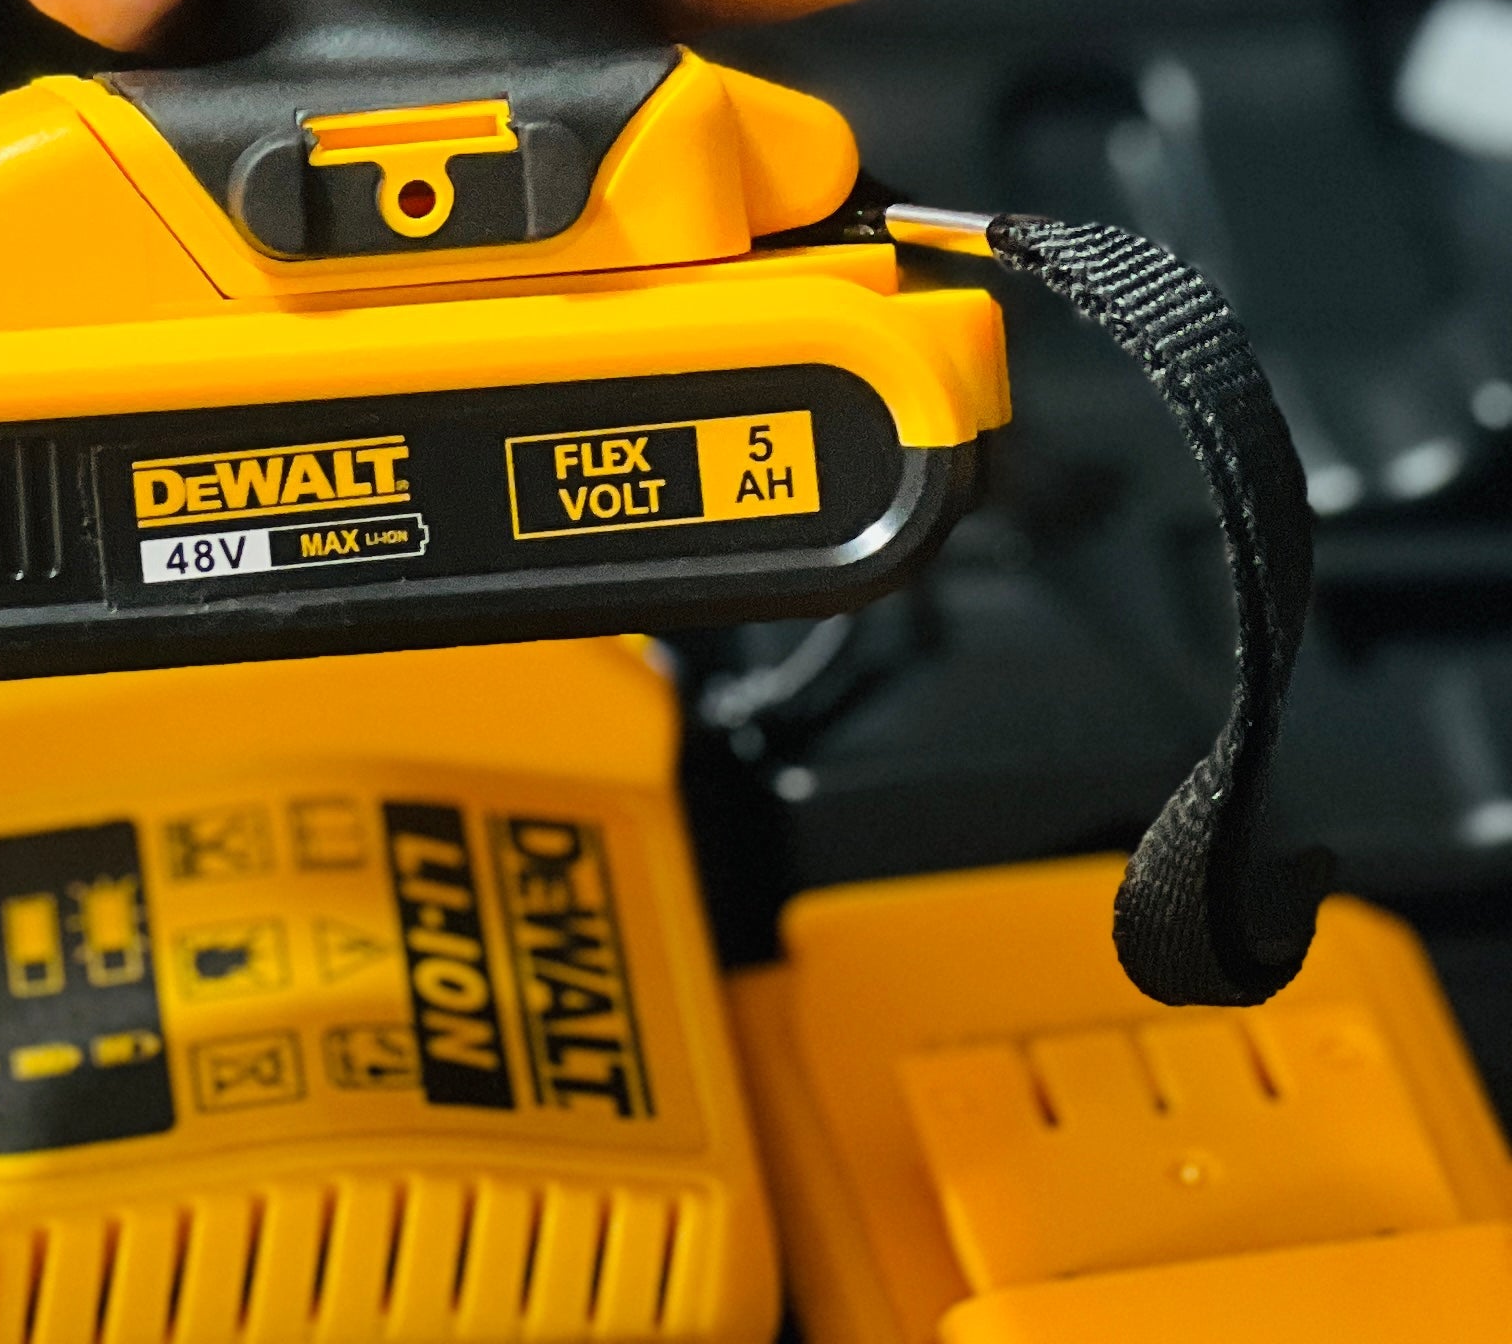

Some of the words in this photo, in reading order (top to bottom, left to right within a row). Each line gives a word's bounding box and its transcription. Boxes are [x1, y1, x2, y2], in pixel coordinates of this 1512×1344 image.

[553, 436, 653, 480] FLEX
[748, 424, 774, 463] 5
[557, 478, 667, 521] VOLT
[734, 465, 795, 504] AH
[166, 535, 247, 575] 48V
[299, 528, 361, 559] MAX
